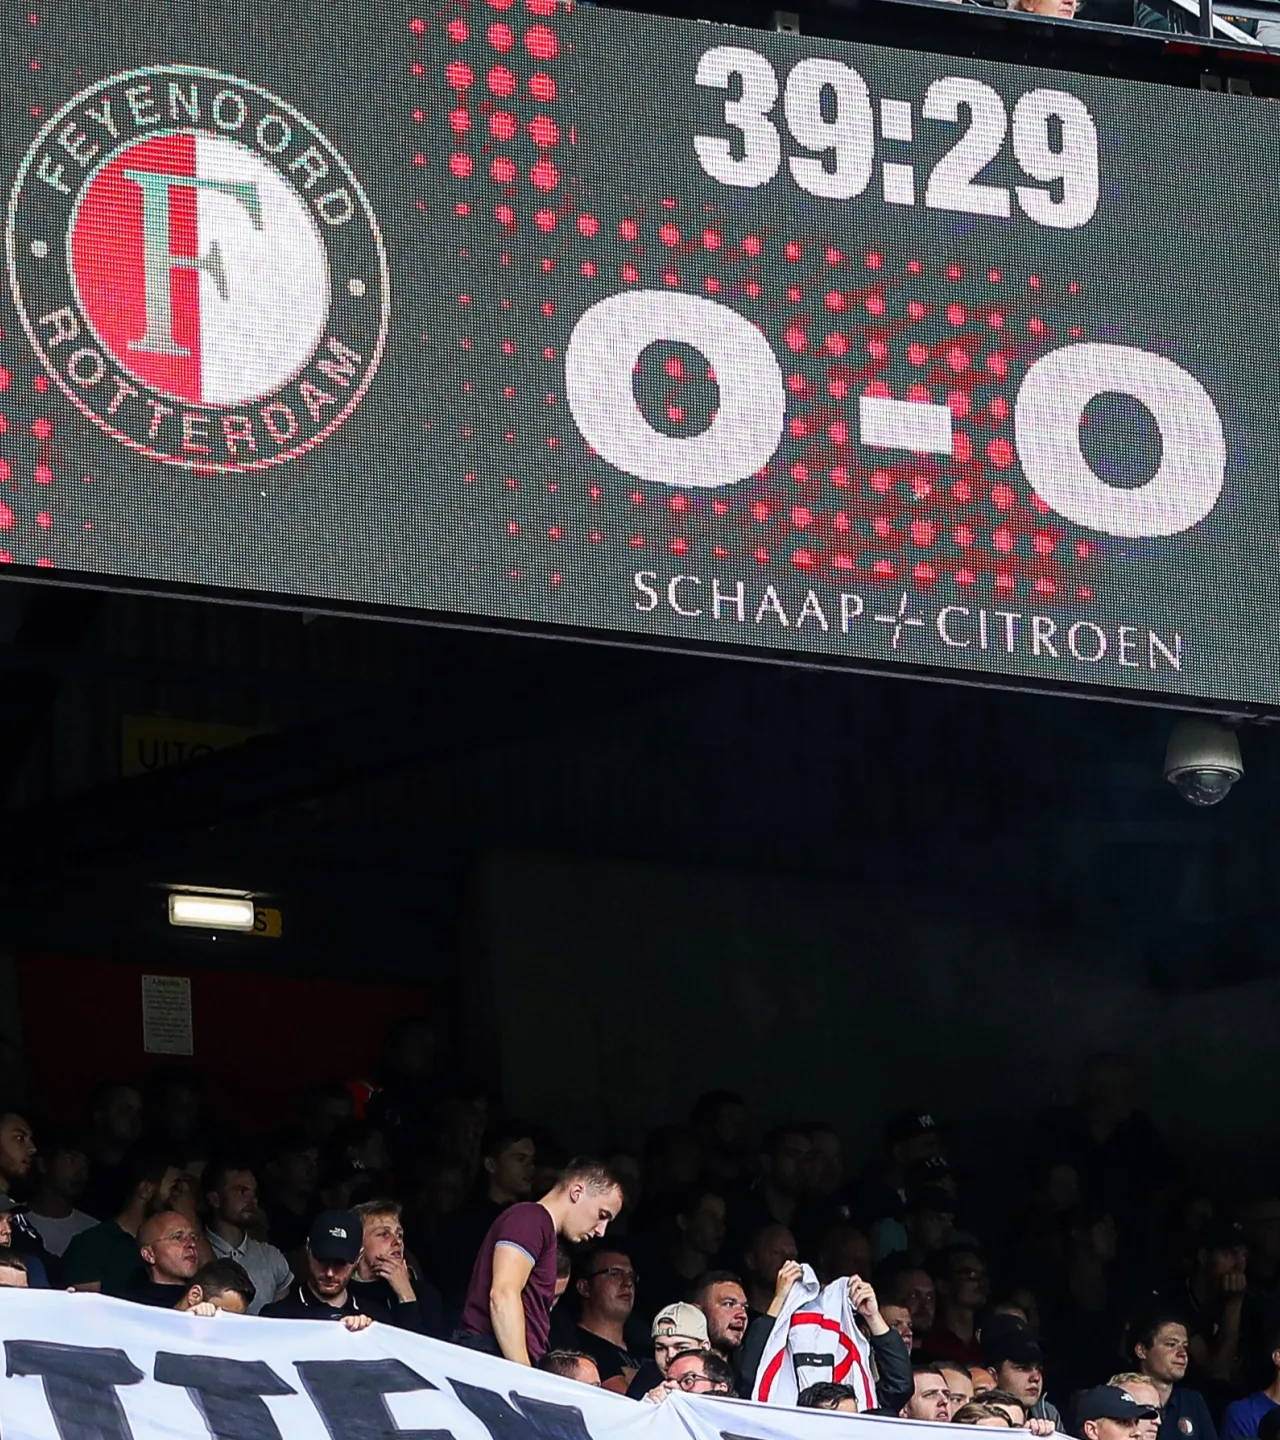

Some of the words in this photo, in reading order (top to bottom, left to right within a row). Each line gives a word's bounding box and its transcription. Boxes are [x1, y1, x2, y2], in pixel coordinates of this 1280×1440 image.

[36, 82, 355, 226] FEYENOORD
[693, 45, 1100, 230] 39:29
[39, 305, 363, 457] ROTTERDAM
[564, 289, 787, 489] 0
[1014, 341, 1227, 539] 0
[633, 570, 865, 635] SCHAAP
[935, 605, 1182, 672] CITROEN
